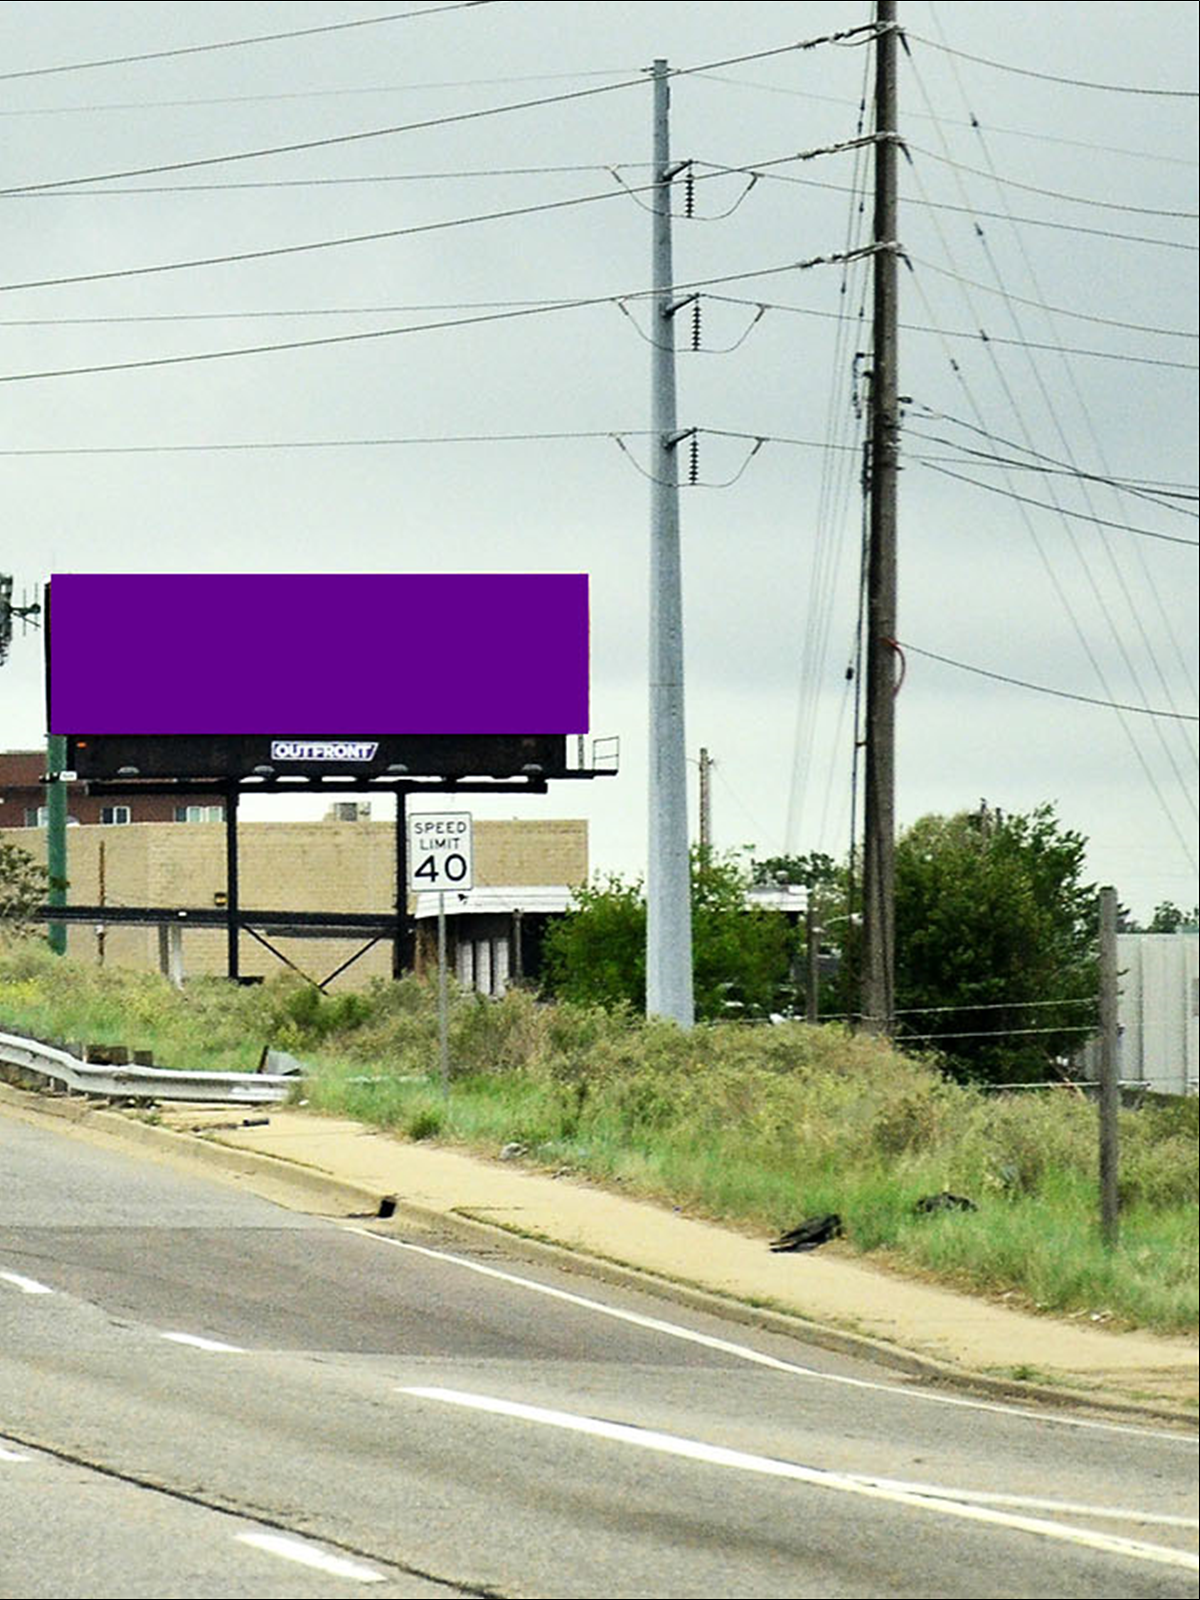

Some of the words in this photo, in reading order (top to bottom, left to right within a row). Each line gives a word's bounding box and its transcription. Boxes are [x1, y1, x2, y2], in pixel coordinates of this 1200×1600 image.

[275, 743, 373, 759] OUTFRONT
[414, 821, 467, 835] SPEED
[419, 837, 460, 851] LIMIT
[414, 853, 467, 882] 40
